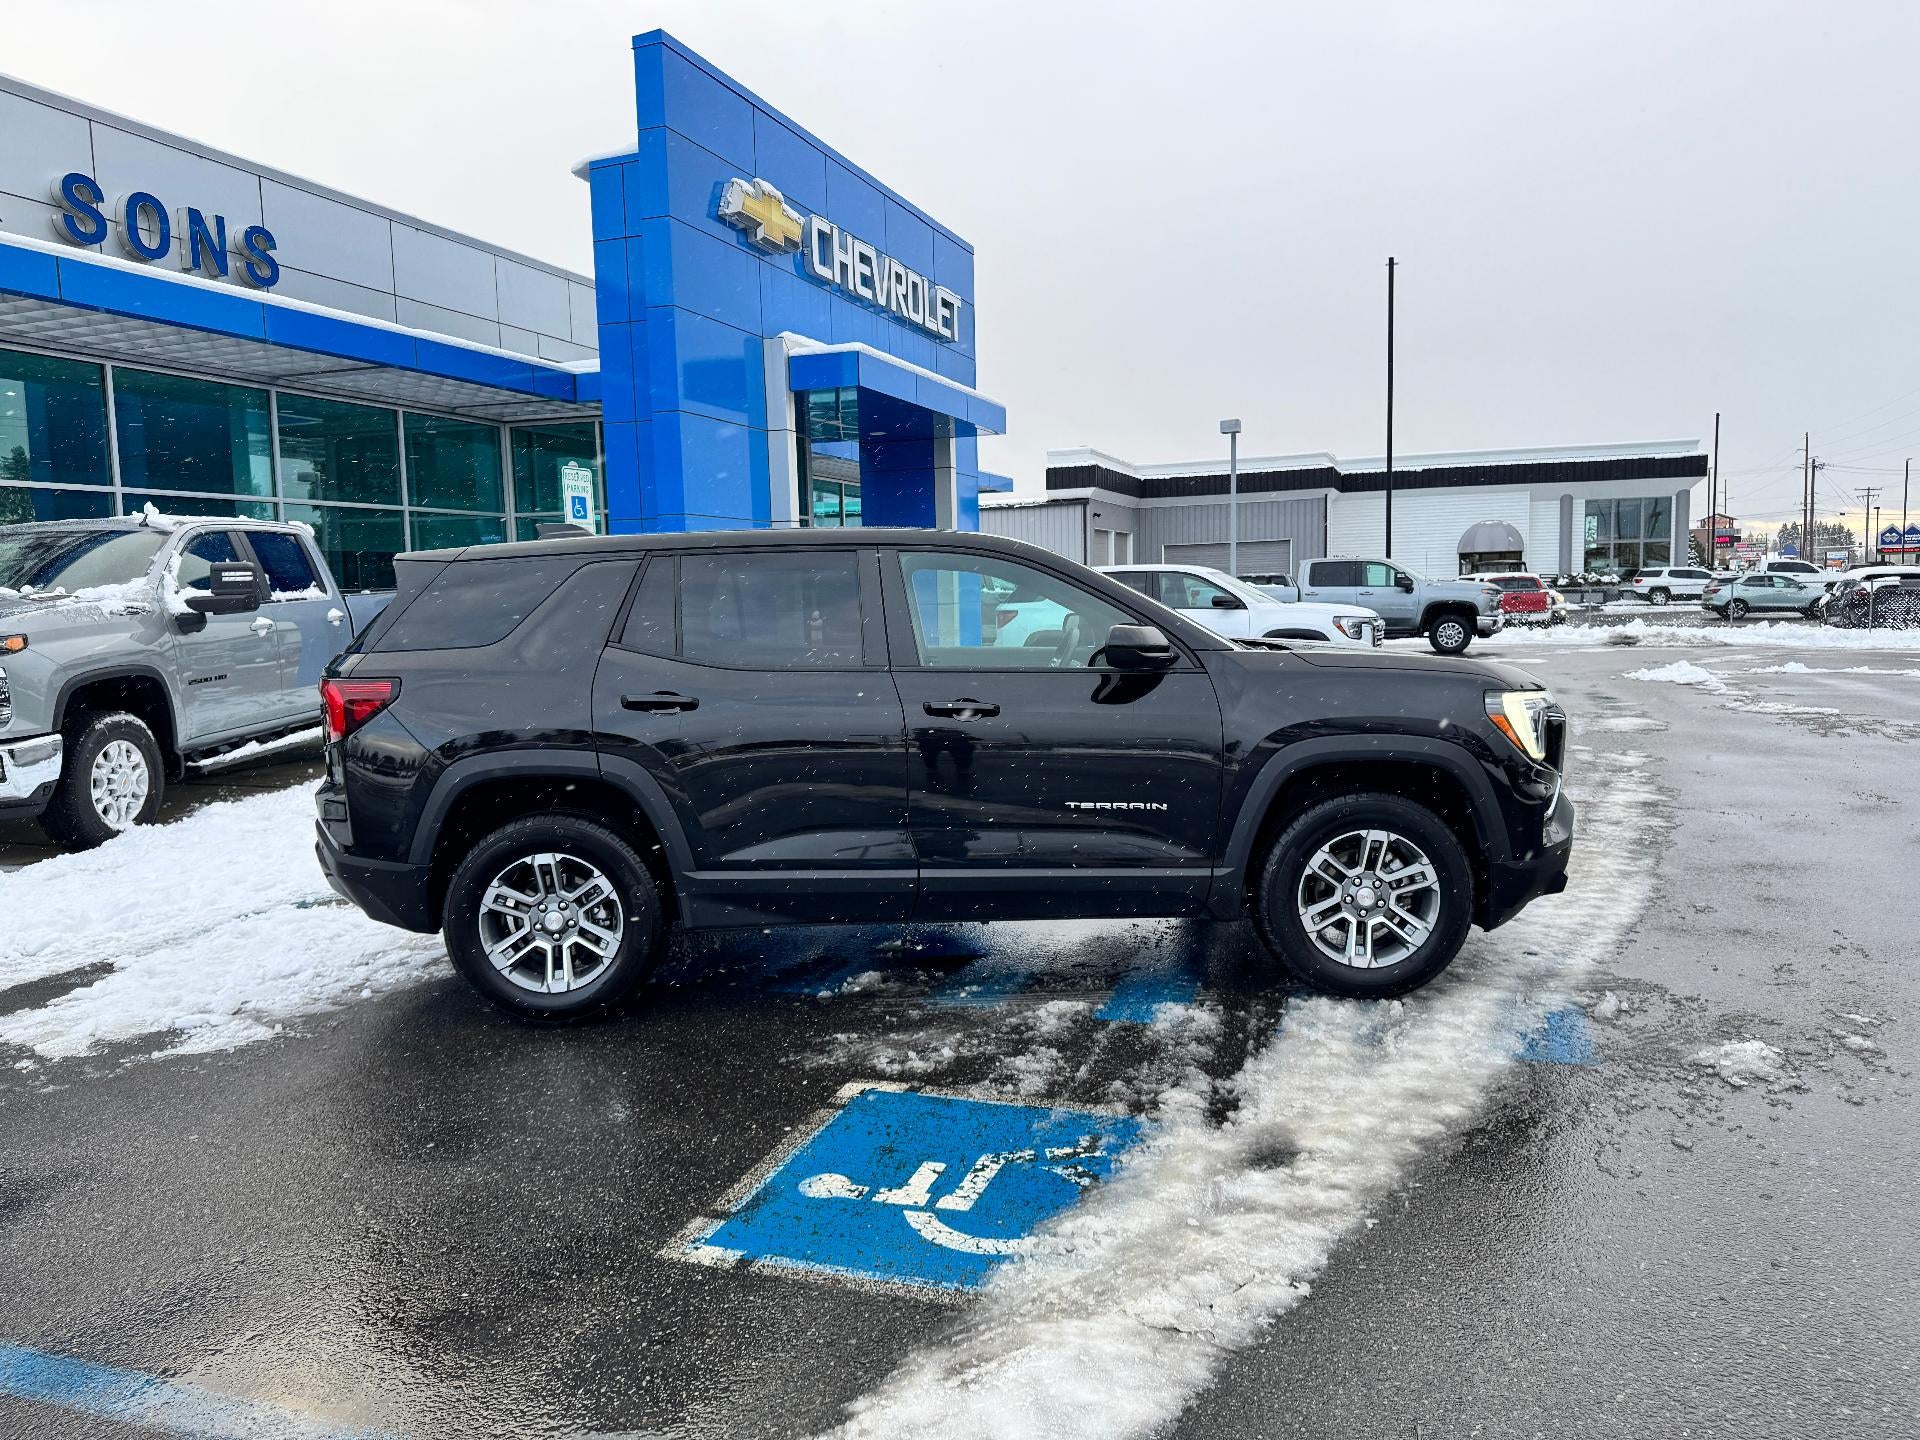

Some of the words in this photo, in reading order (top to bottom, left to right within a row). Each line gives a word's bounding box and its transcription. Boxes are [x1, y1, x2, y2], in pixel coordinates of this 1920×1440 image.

[51, 172, 280, 289] SONS
[805, 214, 961, 343] CHEVROLET
[564, 472, 590, 483] RESERVED
[566, 483, 590, 494] PARKING
[188, 676, 213, 686] 2500
[214, 674, 228, 682] HD
[1064, 801, 1168, 811] TERRAIN
